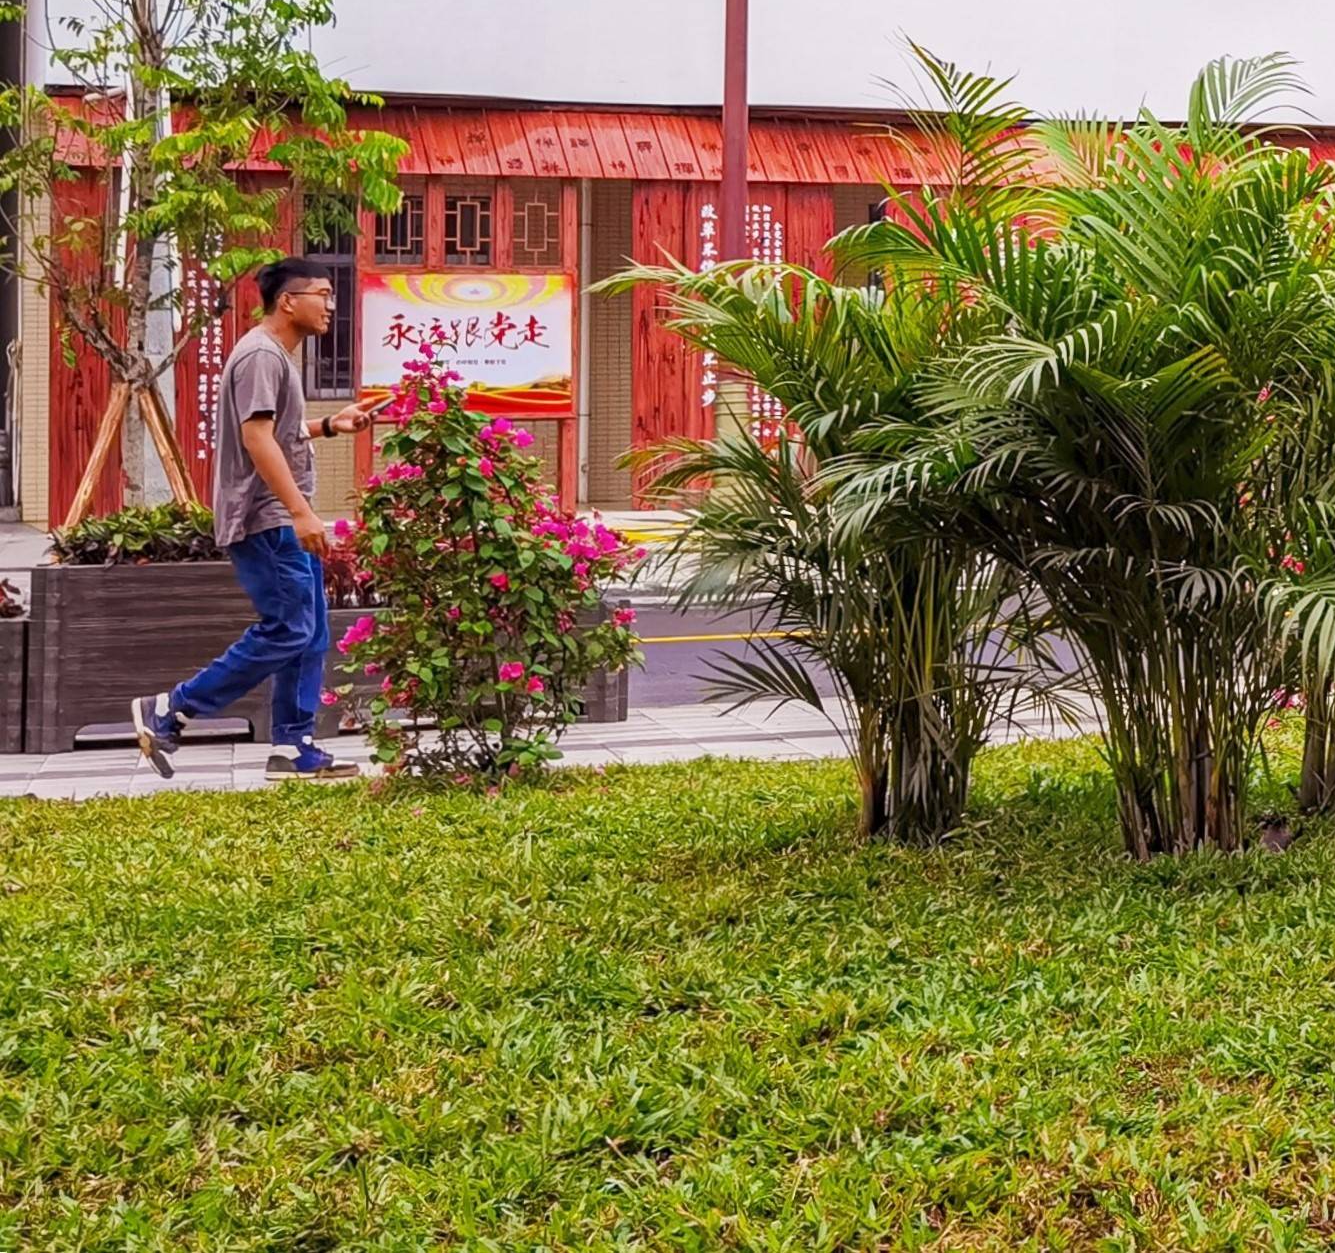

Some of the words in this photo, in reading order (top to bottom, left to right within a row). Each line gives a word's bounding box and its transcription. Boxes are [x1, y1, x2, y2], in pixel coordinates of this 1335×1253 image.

[382, 311, 550, 351] 永远跟党走
